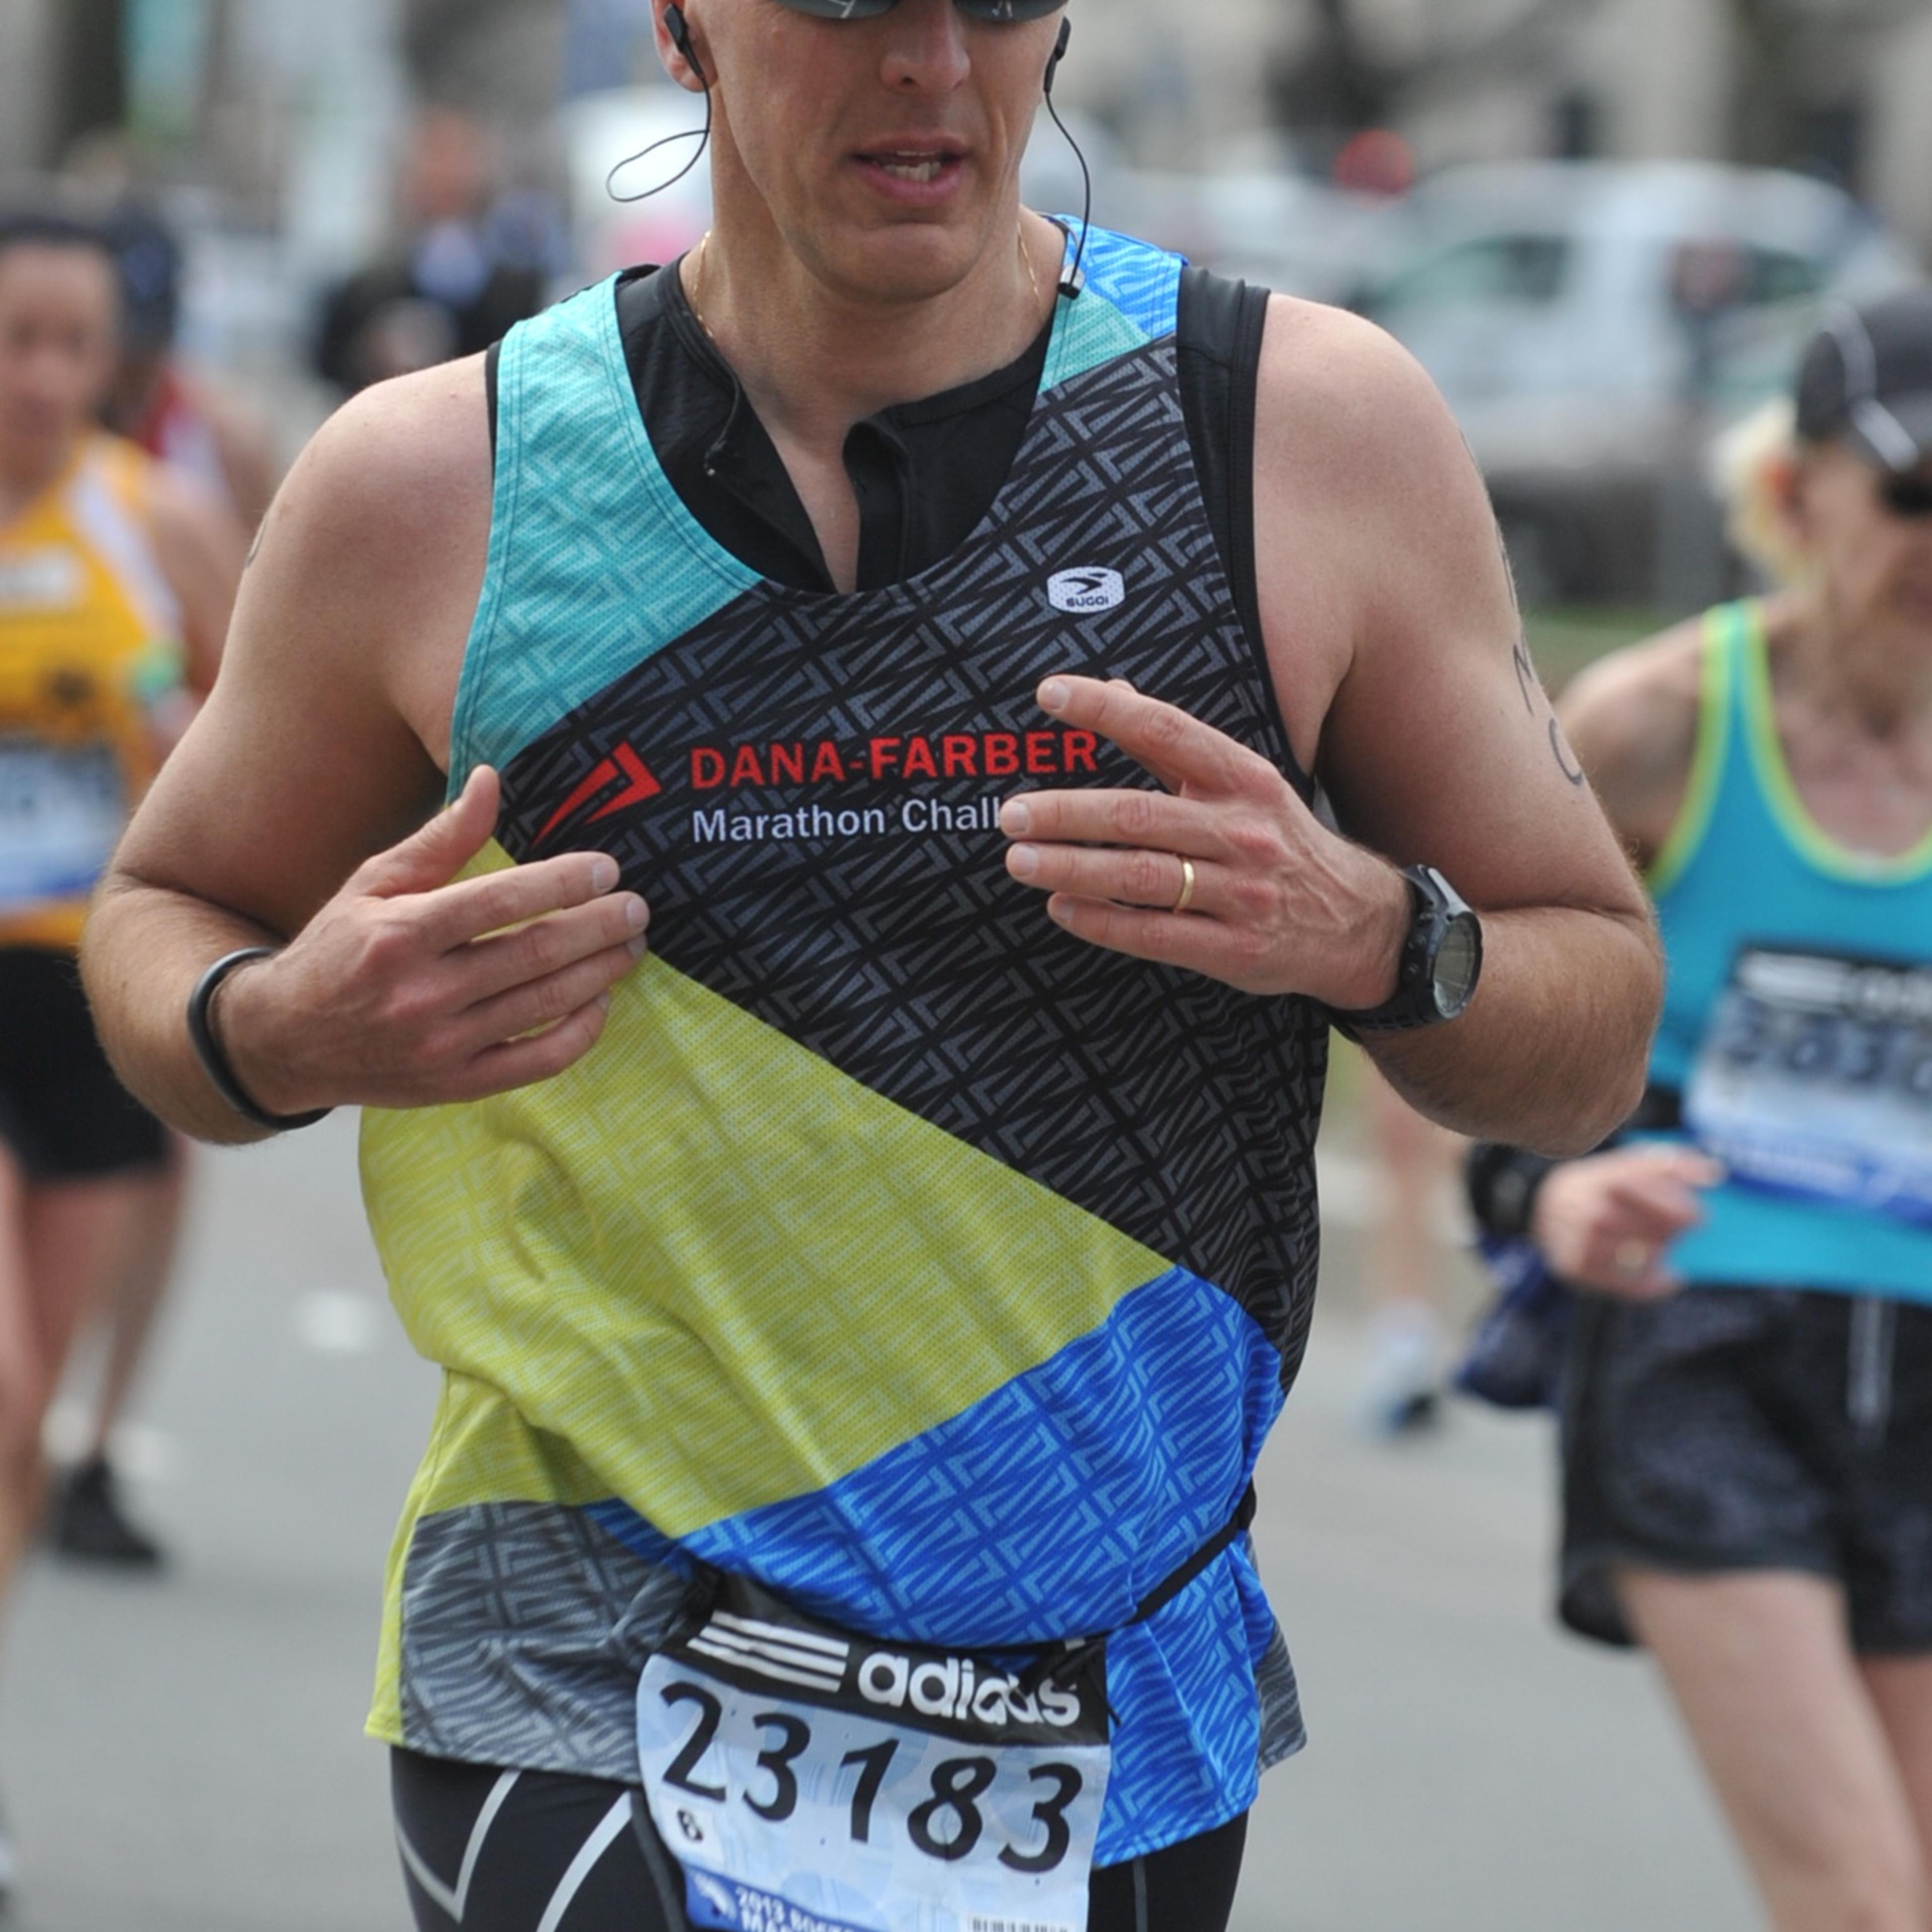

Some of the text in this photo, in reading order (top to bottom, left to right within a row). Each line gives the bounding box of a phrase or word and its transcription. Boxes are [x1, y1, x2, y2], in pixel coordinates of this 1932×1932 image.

[691, 730, 1098, 789] DANA-FARBER
[692, 796, 1001, 843] Marathon Chall
[857, 1652, 1081, 1727] adidas
[660, 1680, 1083, 1873] 23183
